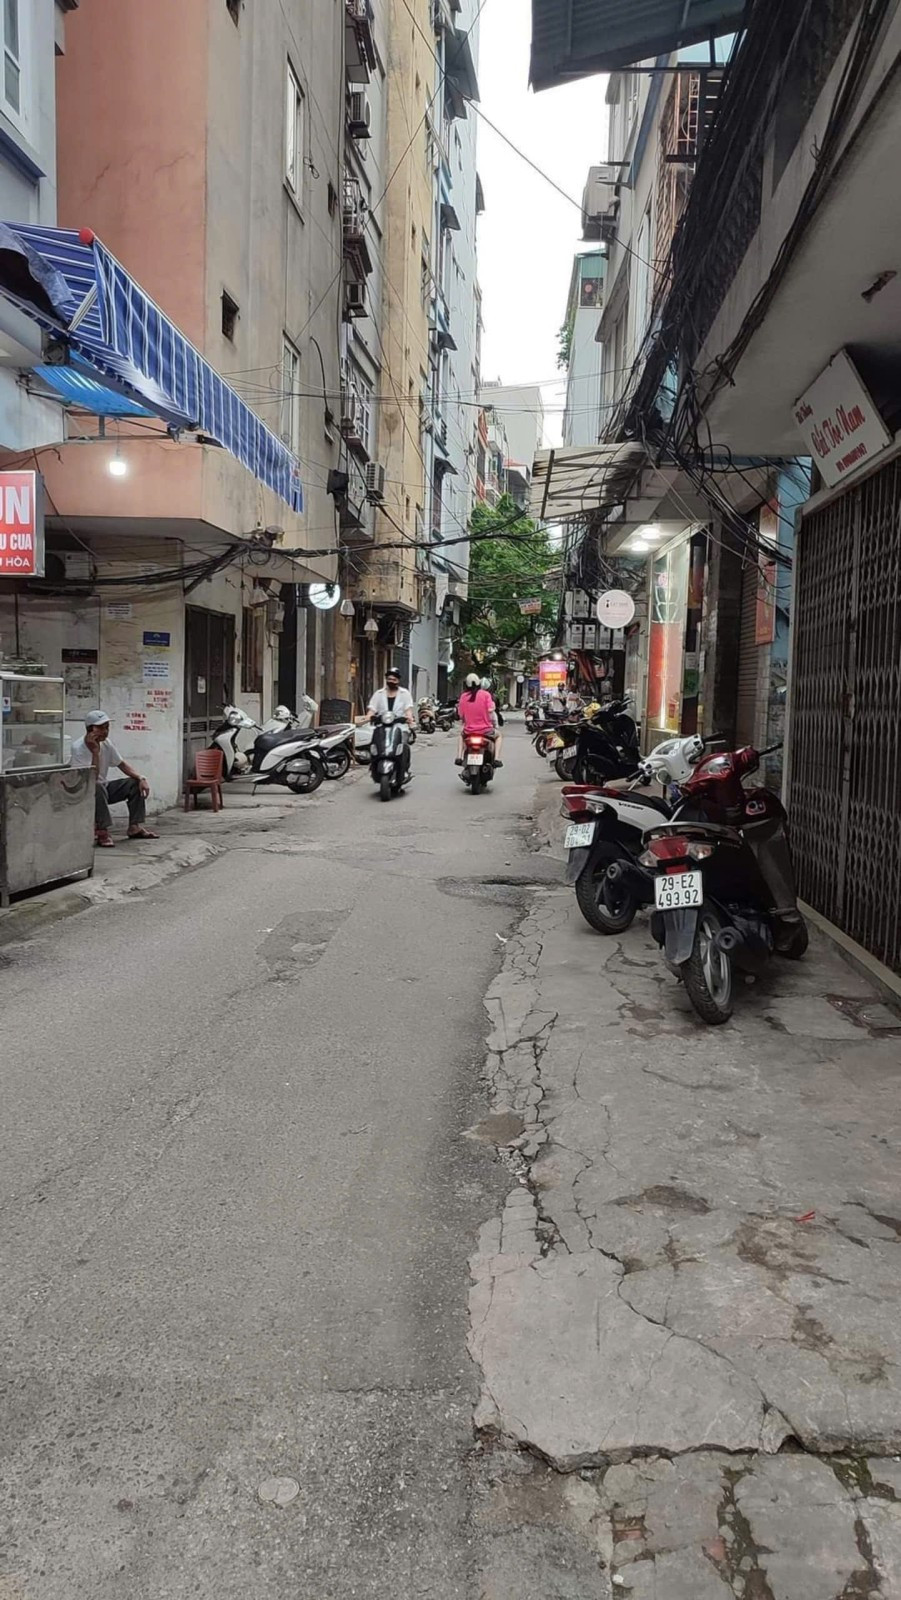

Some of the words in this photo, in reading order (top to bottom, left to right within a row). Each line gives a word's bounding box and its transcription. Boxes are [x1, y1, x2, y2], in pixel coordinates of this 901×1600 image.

[10, 533, 33, 550] CUA
[6, 555, 31, 567] HÒA
[661, 874, 695, 892] 29-E2
[658, 889, 699, 908] 493.92
